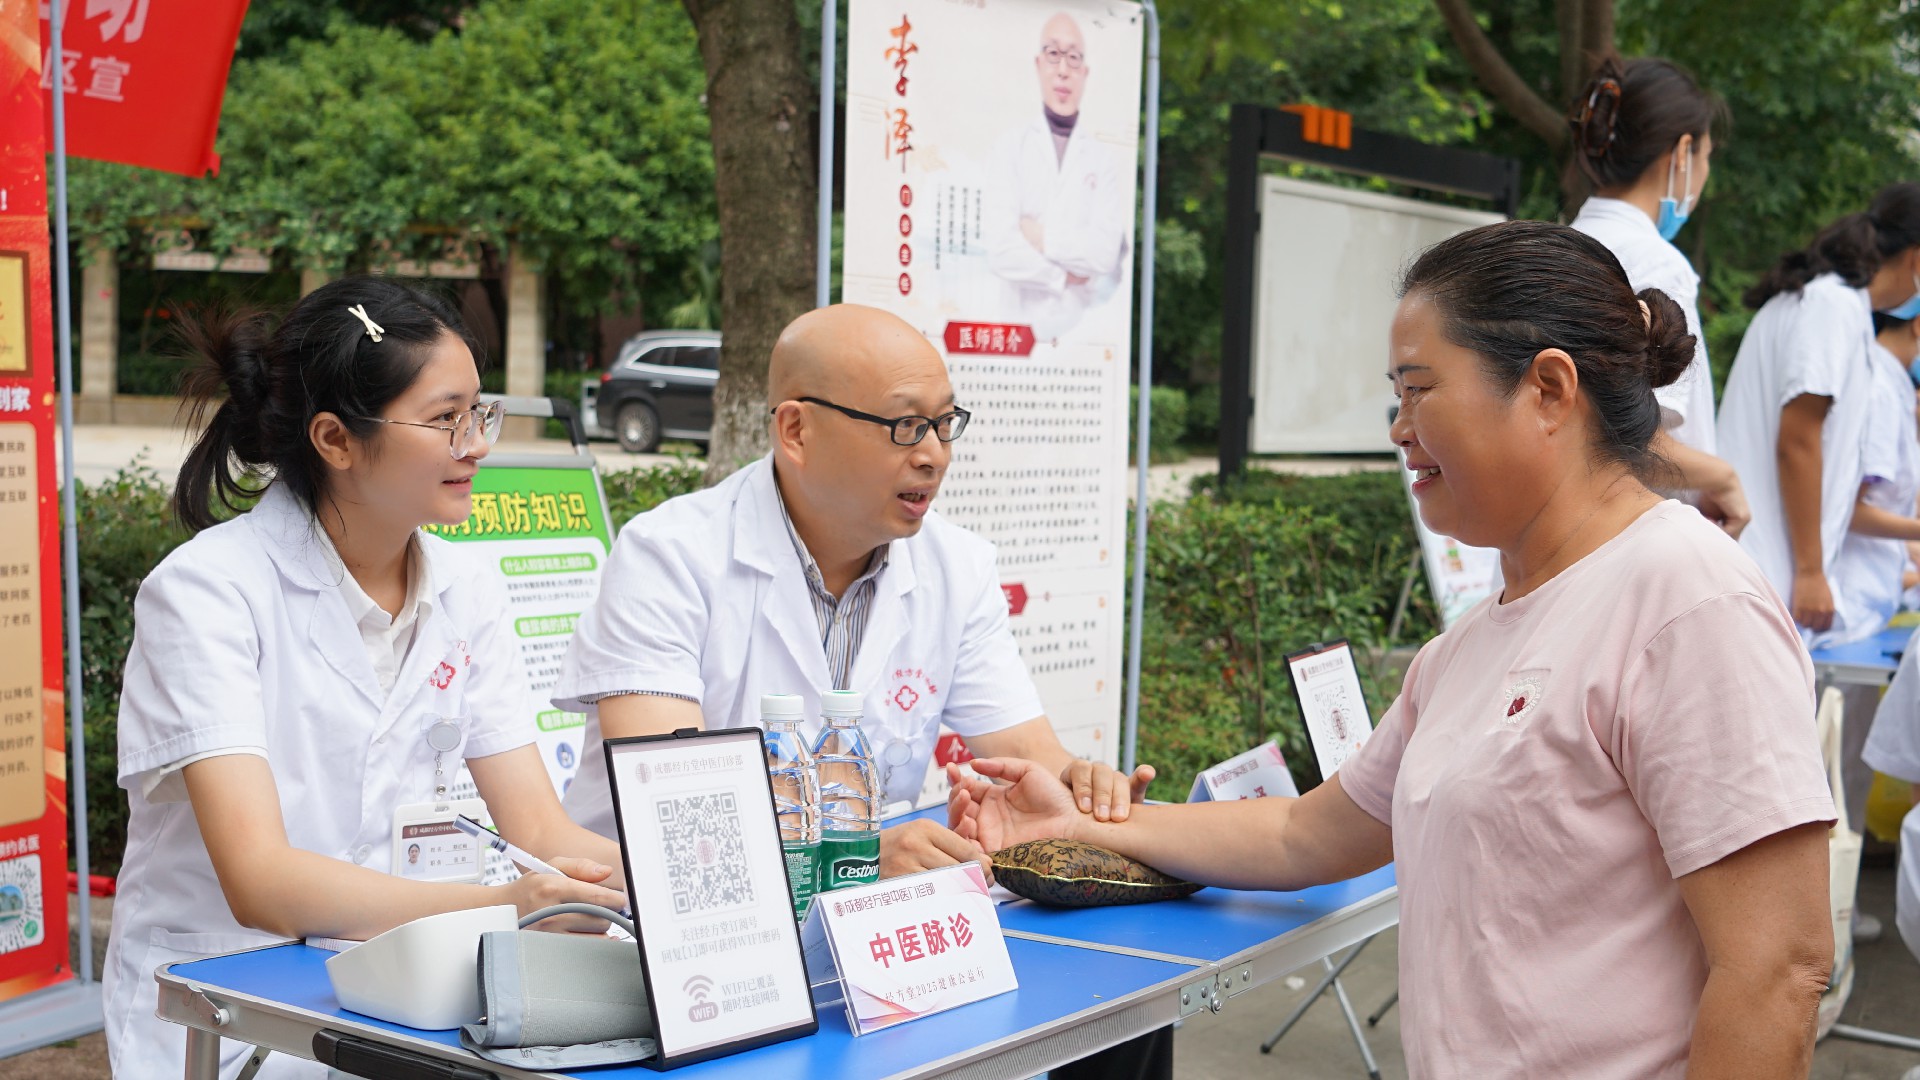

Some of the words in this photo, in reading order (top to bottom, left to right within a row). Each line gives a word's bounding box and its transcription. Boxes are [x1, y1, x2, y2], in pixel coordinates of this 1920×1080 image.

[959, 327, 1022, 352] 医师简介
[0, 687, 33, 702] 以降低
[654, 755, 744, 774] 成都经方堂中医门诊部
[844, 882, 935, 914] 成都经方堂中医门诊部
[681, 916, 758, 942] 关注经方堂订阅号
[869, 912, 974, 969] 中医脉诊
[692, 1005, 716, 1020] WIFI
[722, 989, 780, 1013] 随时连接网络
